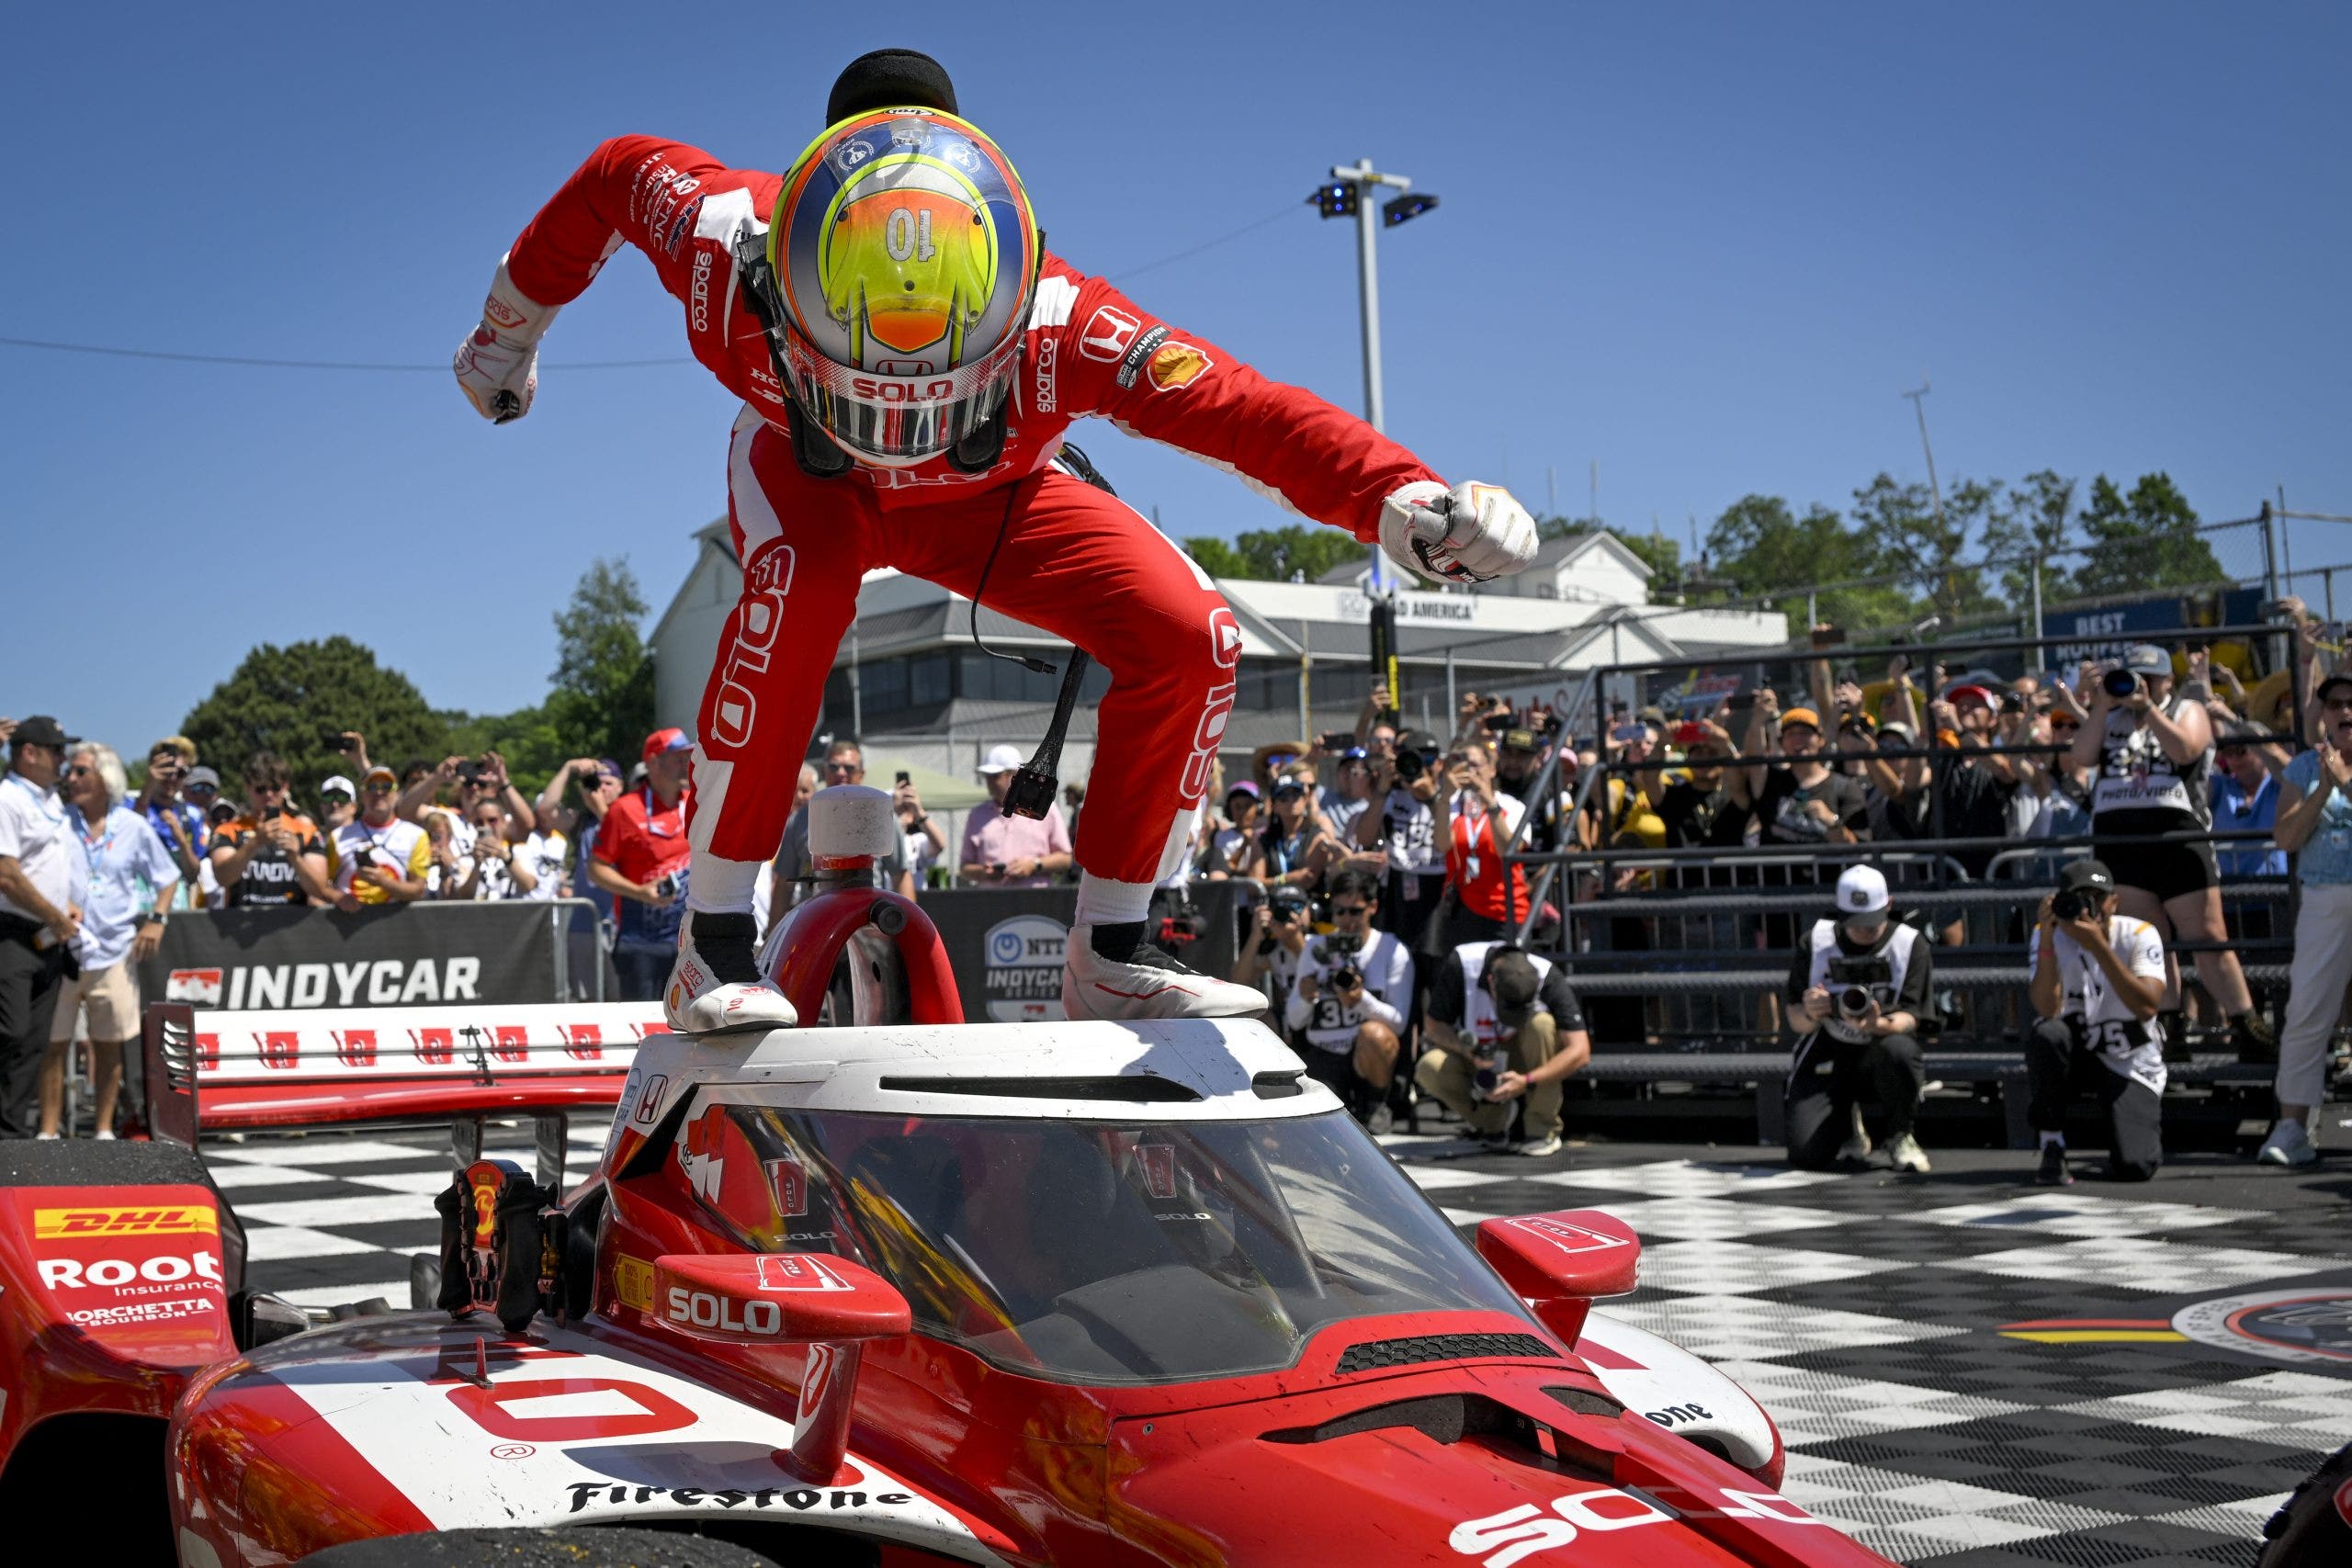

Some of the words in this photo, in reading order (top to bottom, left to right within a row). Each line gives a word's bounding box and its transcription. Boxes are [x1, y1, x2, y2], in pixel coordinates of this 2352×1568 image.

[886, 207, 935, 262] 10
[692, 250, 714, 333] sparco
[1127, 324, 1167, 366] CHAMPION
[1036, 337, 1059, 413] sparco
[852, 378, 954, 402] SOLO
[2075, 611, 2126, 637] BEST
[712, 544, 797, 750] SOLO
[1026, 938, 1065, 955] NTT
[227, 956, 481, 1010] INDYCAR
[986, 970, 1063, 987] INDYCA
[61, 1210, 195, 1233] DHL
[1153, 1213, 1212, 1221] SOLO
[773, 1231, 838, 1242] SOLO
[114, 1280, 224, 1297] Insurance
[89, 1310, 187, 1326] BOURBON
[669, 1286, 781, 1335] SOLO
[565, 1482, 913, 1513] Firestone
